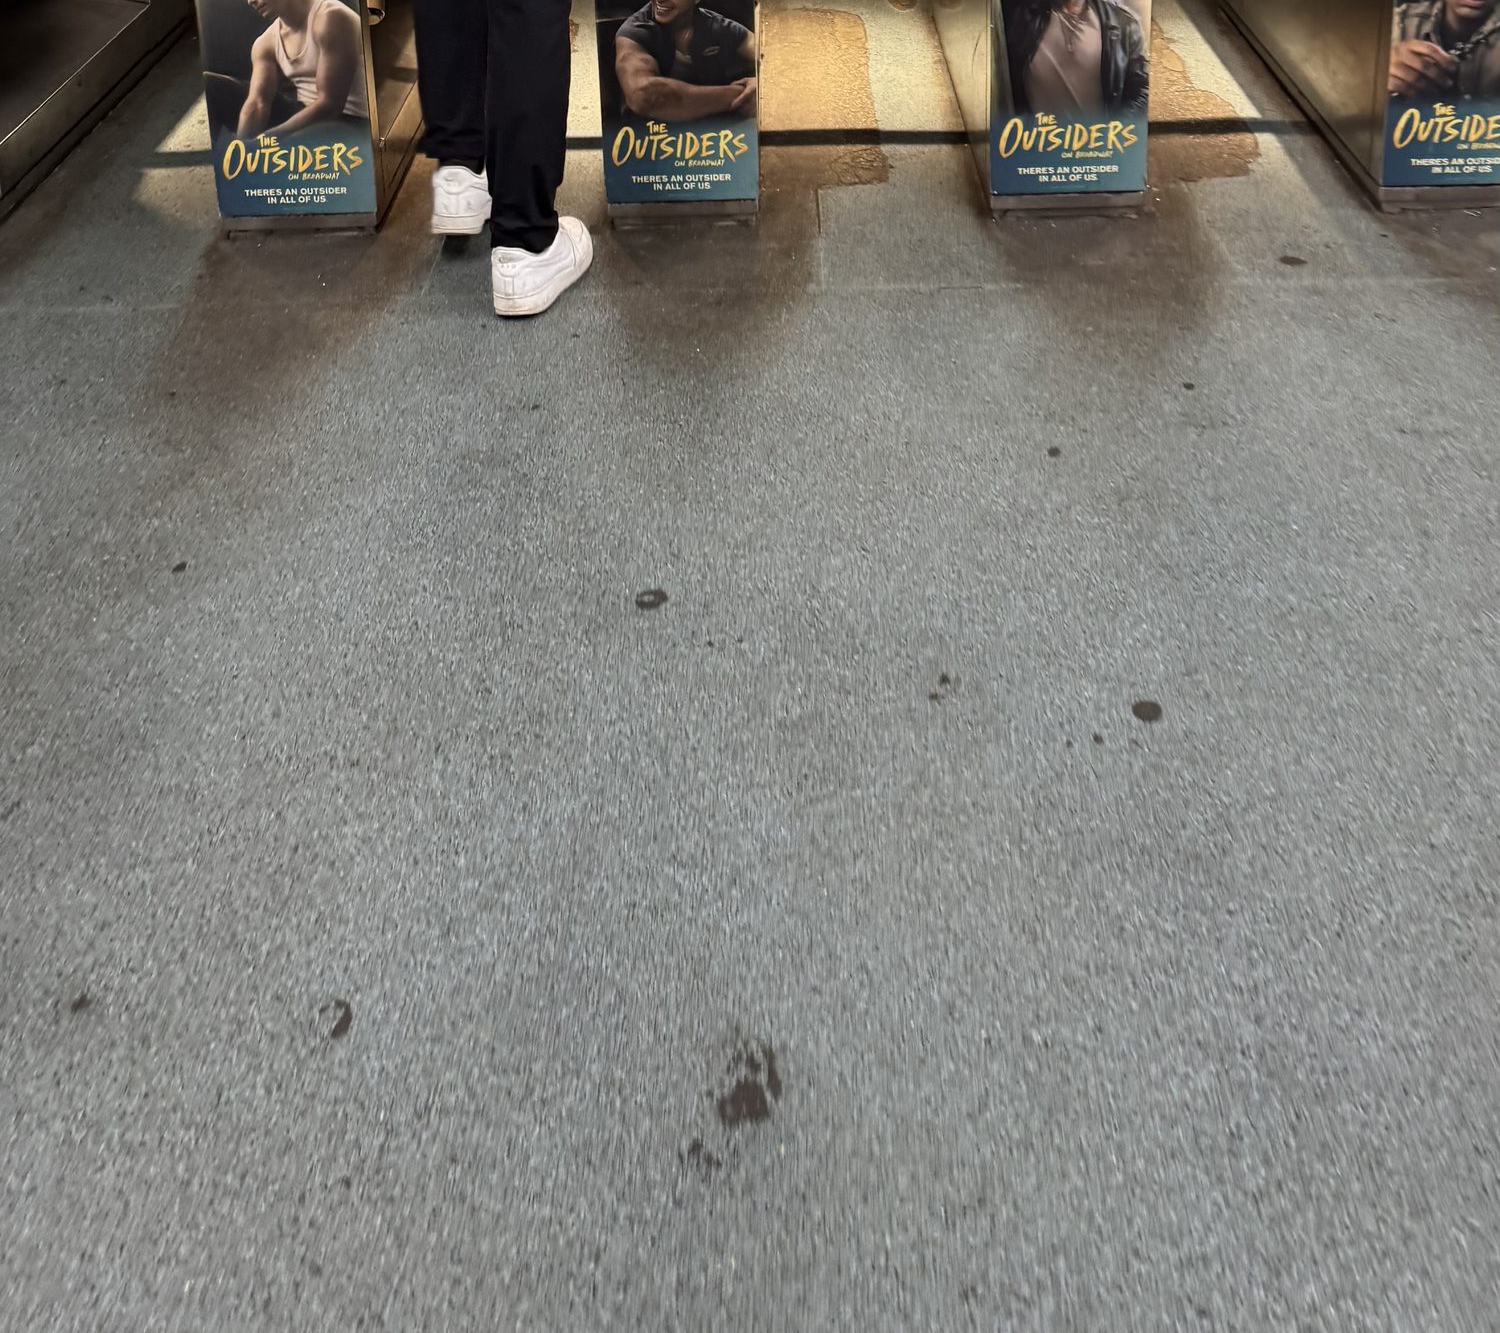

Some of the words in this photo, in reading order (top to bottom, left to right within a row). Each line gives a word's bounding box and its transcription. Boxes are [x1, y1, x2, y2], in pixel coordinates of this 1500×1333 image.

[1433, 103, 1456, 116] THE
[1035, 112, 1057, 125] THE
[646, 120, 668, 133] THE
[257, 133, 280, 147] THE
[999, 117, 1138, 158] OUTSIDERS
[612, 126, 749, 166] OUTSIDERS
[223, 139, 363, 180] OUTSIDERS
[688, 159, 725, 167] BROADWAY
[1057, 166, 1070, 174] AN
[1072, 165, 1119, 174] OUTSIDER
[288, 173, 299, 181] ON
[302, 172, 340, 181] BROADWAY
[670, 175, 683, 183] AN
[685, 174, 731, 182] OUTSIDER
[1050, 174, 1067, 182] ALL
[653, 183, 663, 191] IN
[683, 182, 696, 190] OF
[285, 188, 297, 196] AN
[300, 187, 347, 195] OUTSIDER
[267, 196, 277, 204] IN
[280, 196, 296, 204] ALL
